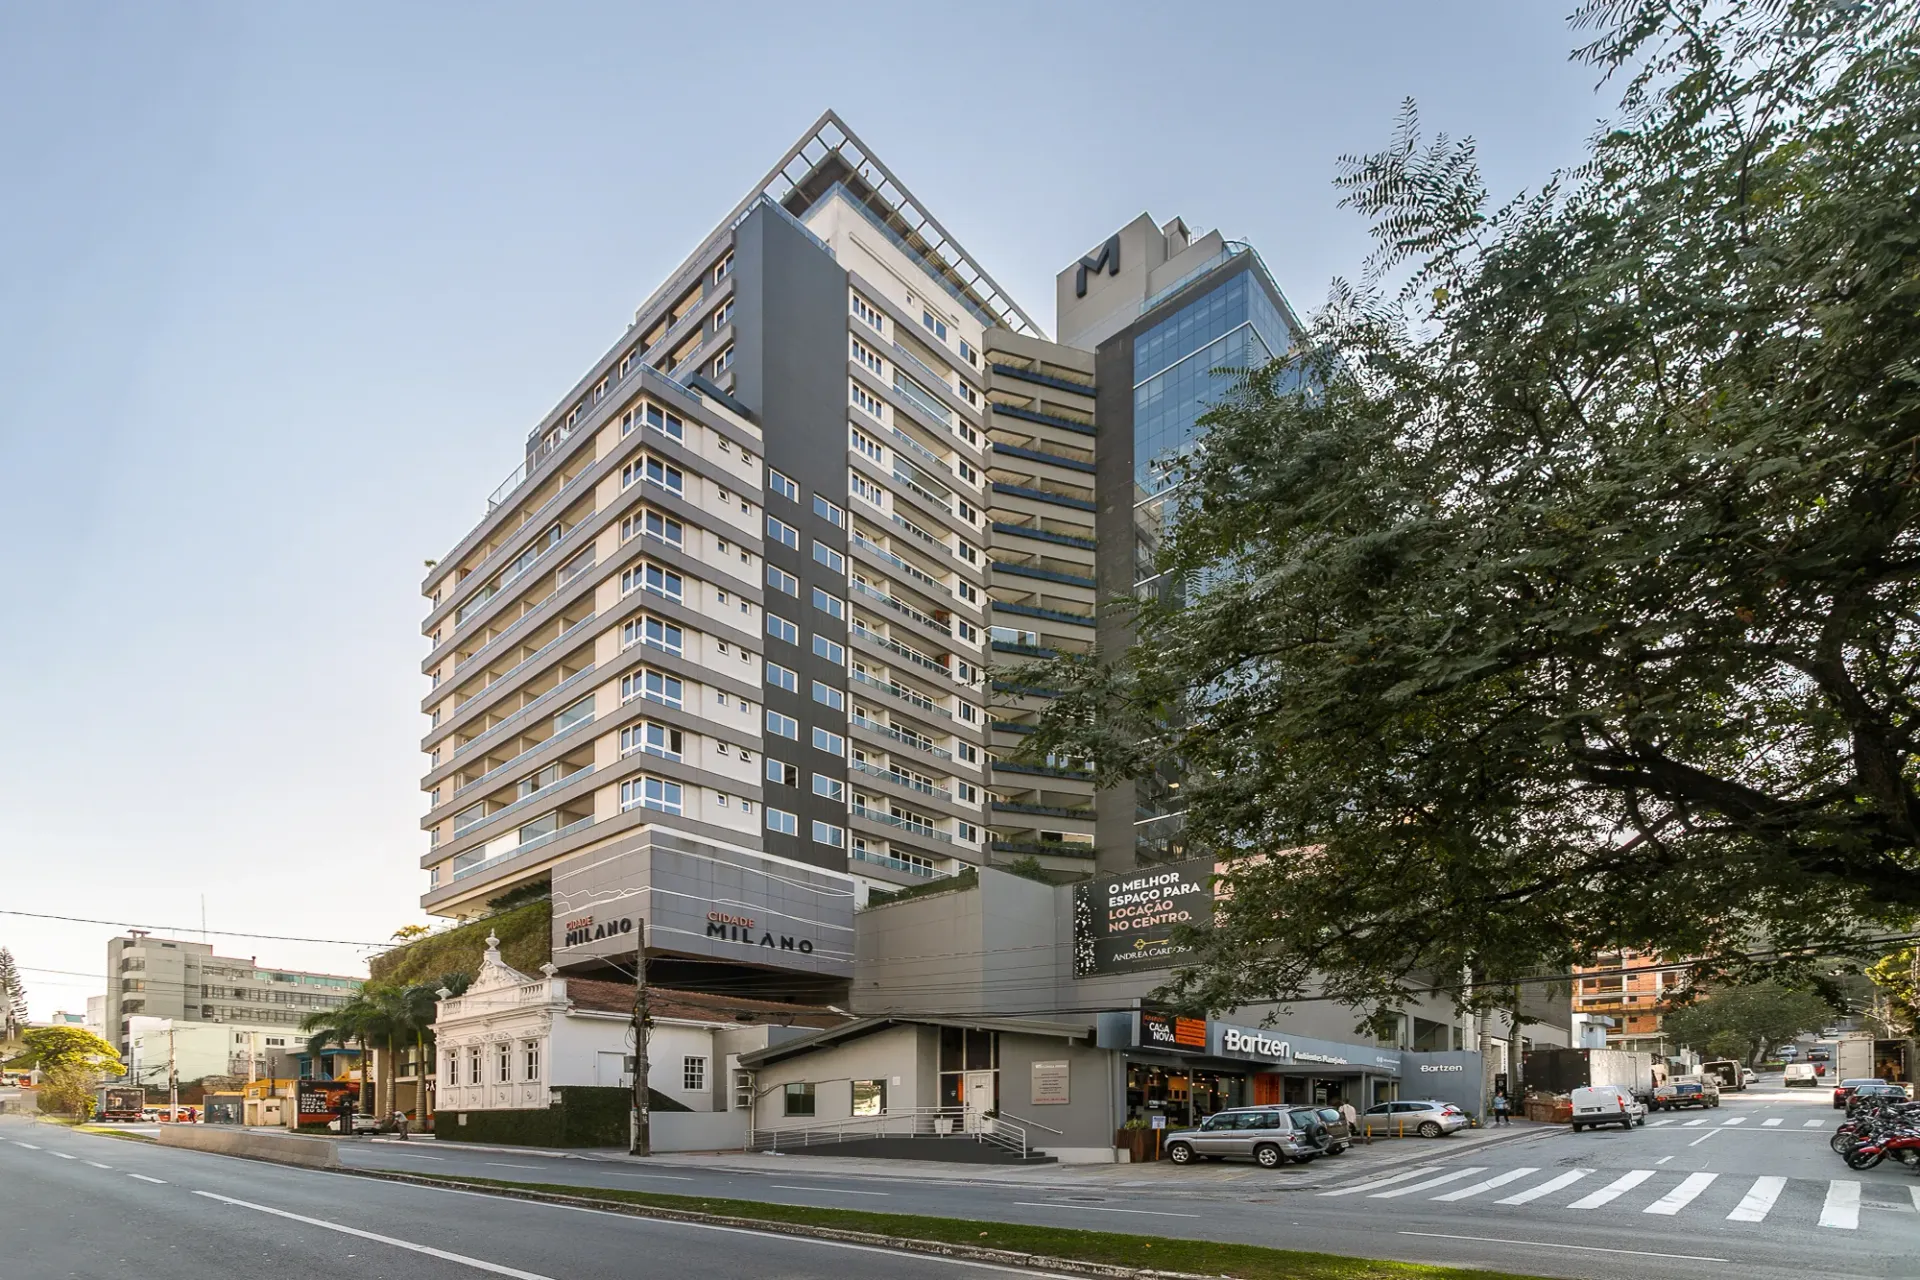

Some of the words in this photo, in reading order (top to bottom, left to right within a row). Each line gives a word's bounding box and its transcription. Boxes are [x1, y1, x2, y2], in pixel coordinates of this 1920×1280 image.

[1076, 233, 1120, 299] M
[1109, 884, 1119, 894] O
[1122, 872, 1180, 892] MELHOR
[1109, 889, 1160, 907] ESPAÇO
[1163, 882, 1201, 897] PARA
[707, 912, 755, 928] CIDADE
[1109, 900, 1173, 920] LOCAÇÃO
[1109, 920, 1129, 932] NO
[1132, 910, 1192, 928] CENTRO.
[566, 916, 594, 930] CIDADE
[566, 917, 632, 947] MILANO
[707, 922, 813, 953] MILANO
[1112, 951, 1149, 962] ANDREA
[1153, 1031, 1176, 1042] NOVA
[1225, 1029, 1290, 1058] Bartzen
